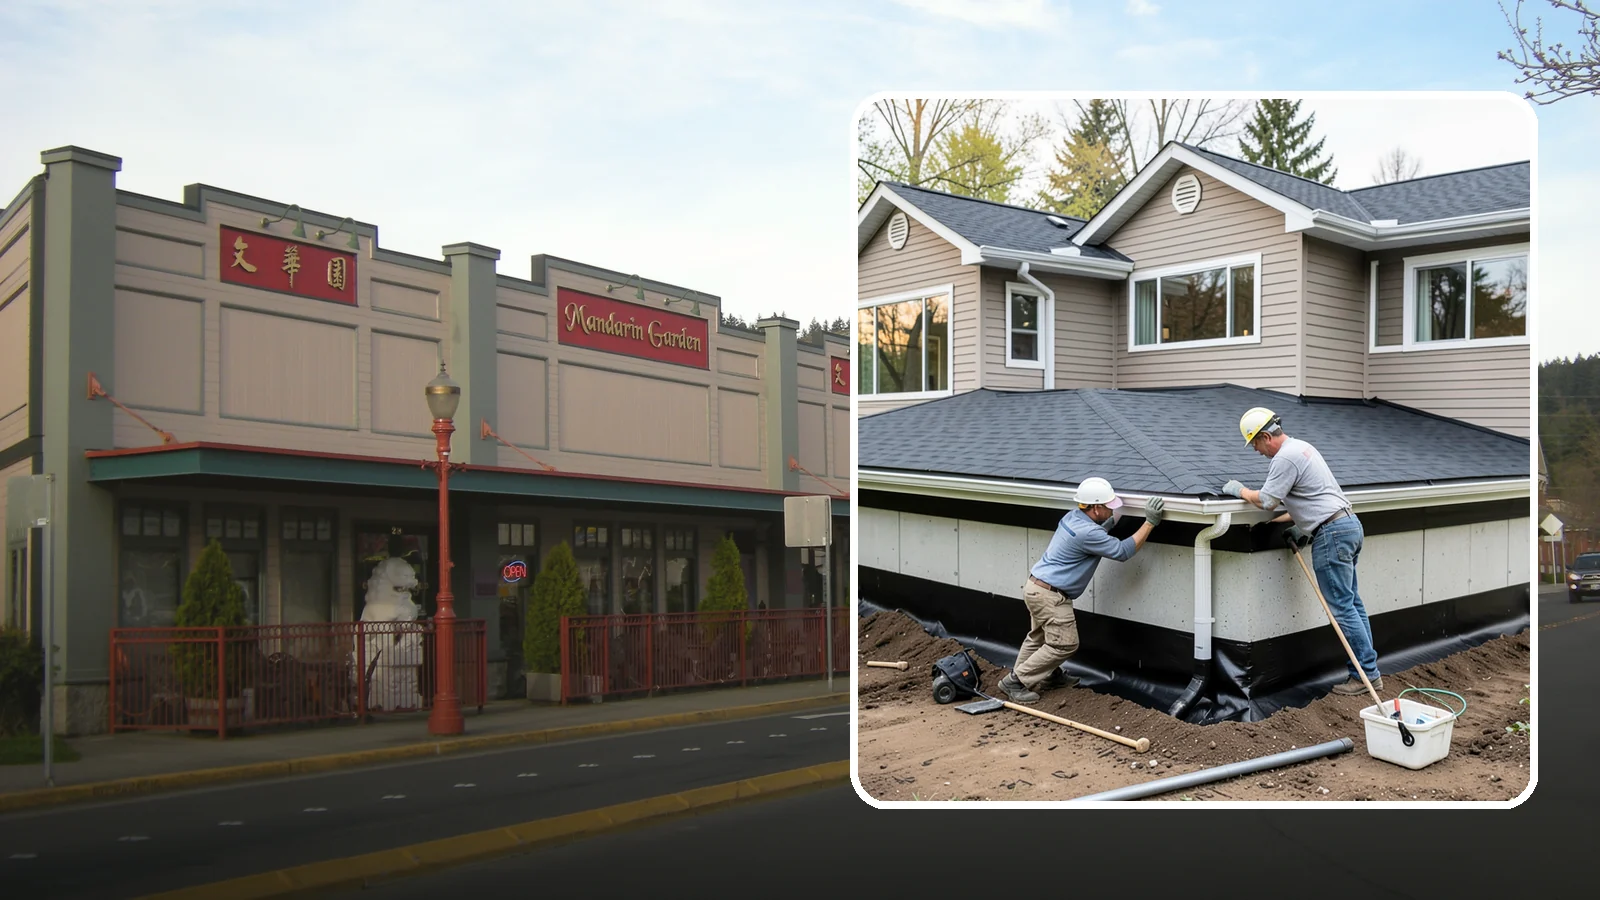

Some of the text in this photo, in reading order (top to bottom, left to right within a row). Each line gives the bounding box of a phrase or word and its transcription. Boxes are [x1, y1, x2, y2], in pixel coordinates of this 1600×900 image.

[564, 302, 701, 352] Mandarin Garden
[503, 565, 527, 578] OPEN
